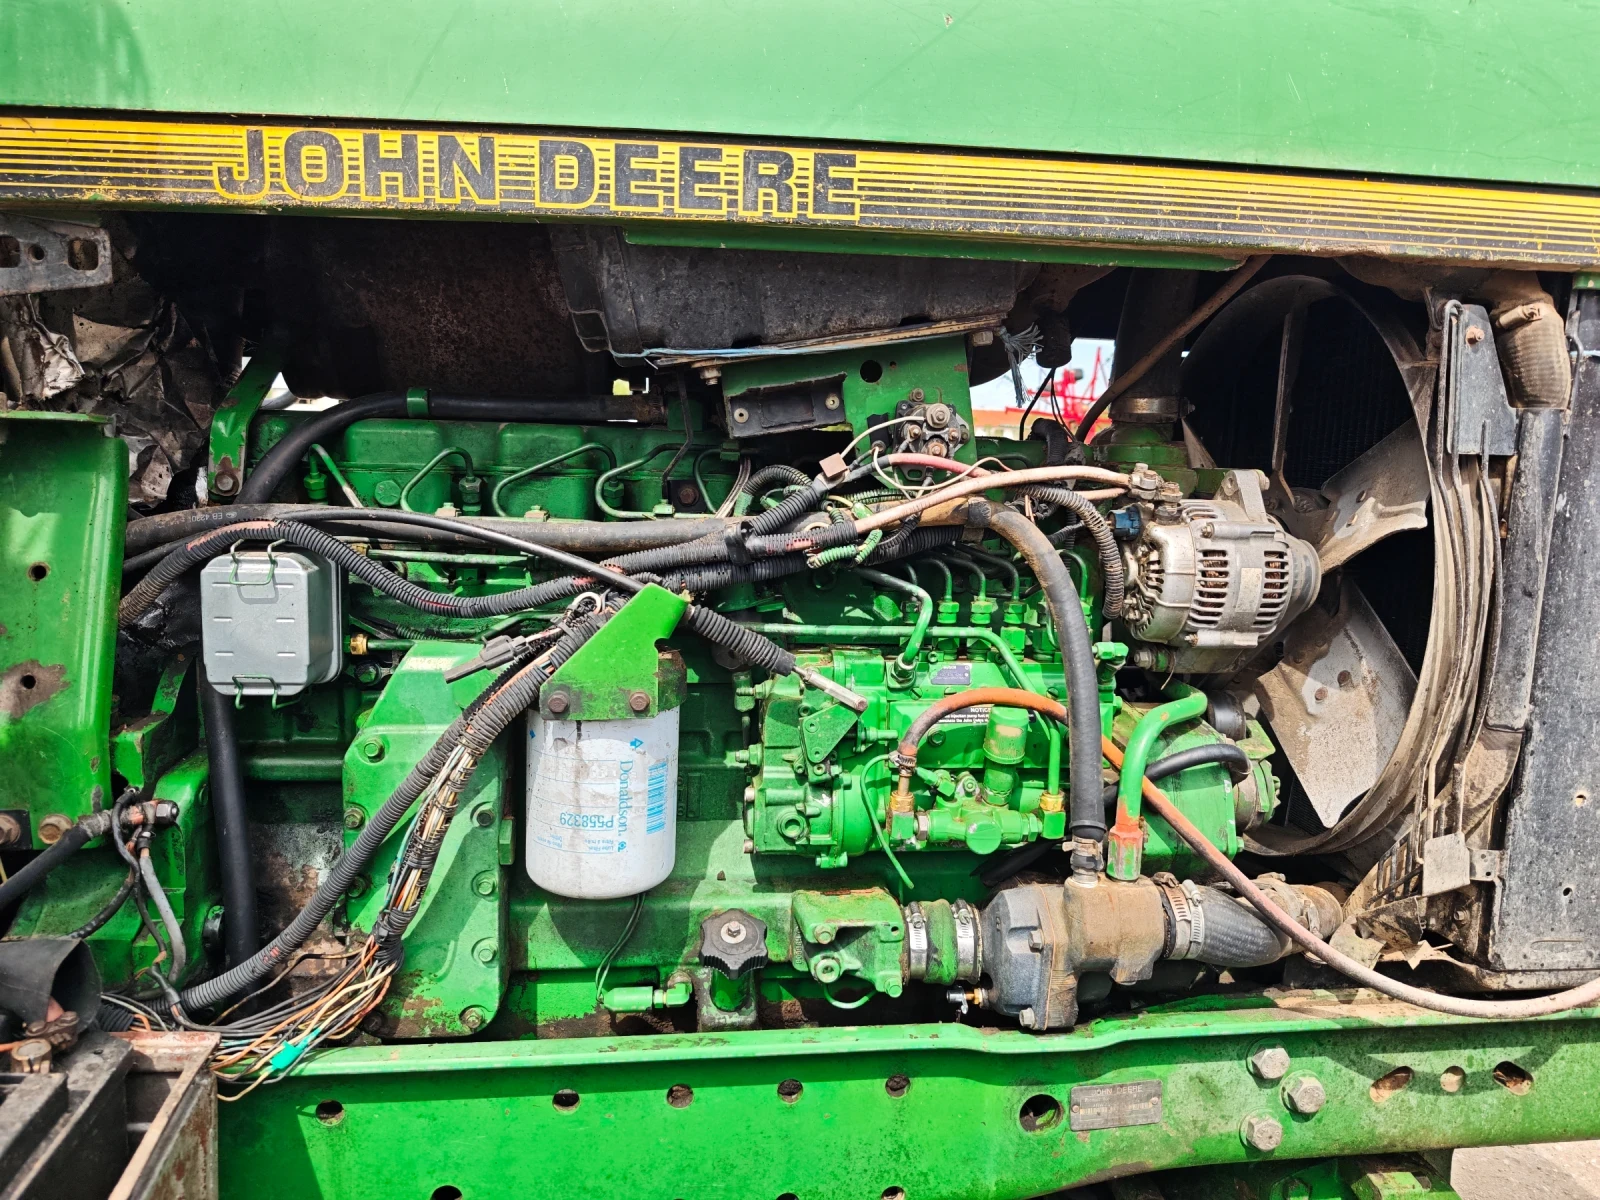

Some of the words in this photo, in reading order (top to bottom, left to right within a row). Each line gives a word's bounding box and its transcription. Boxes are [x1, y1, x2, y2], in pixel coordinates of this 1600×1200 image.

[212, 129, 499, 204] JOHN
[535, 139, 860, 220] DEERE
[559, 812, 614, 828] P558329
[1093, 1088, 1113, 1096] JOHN
[1116, 1084, 1143, 1094] DEERE
